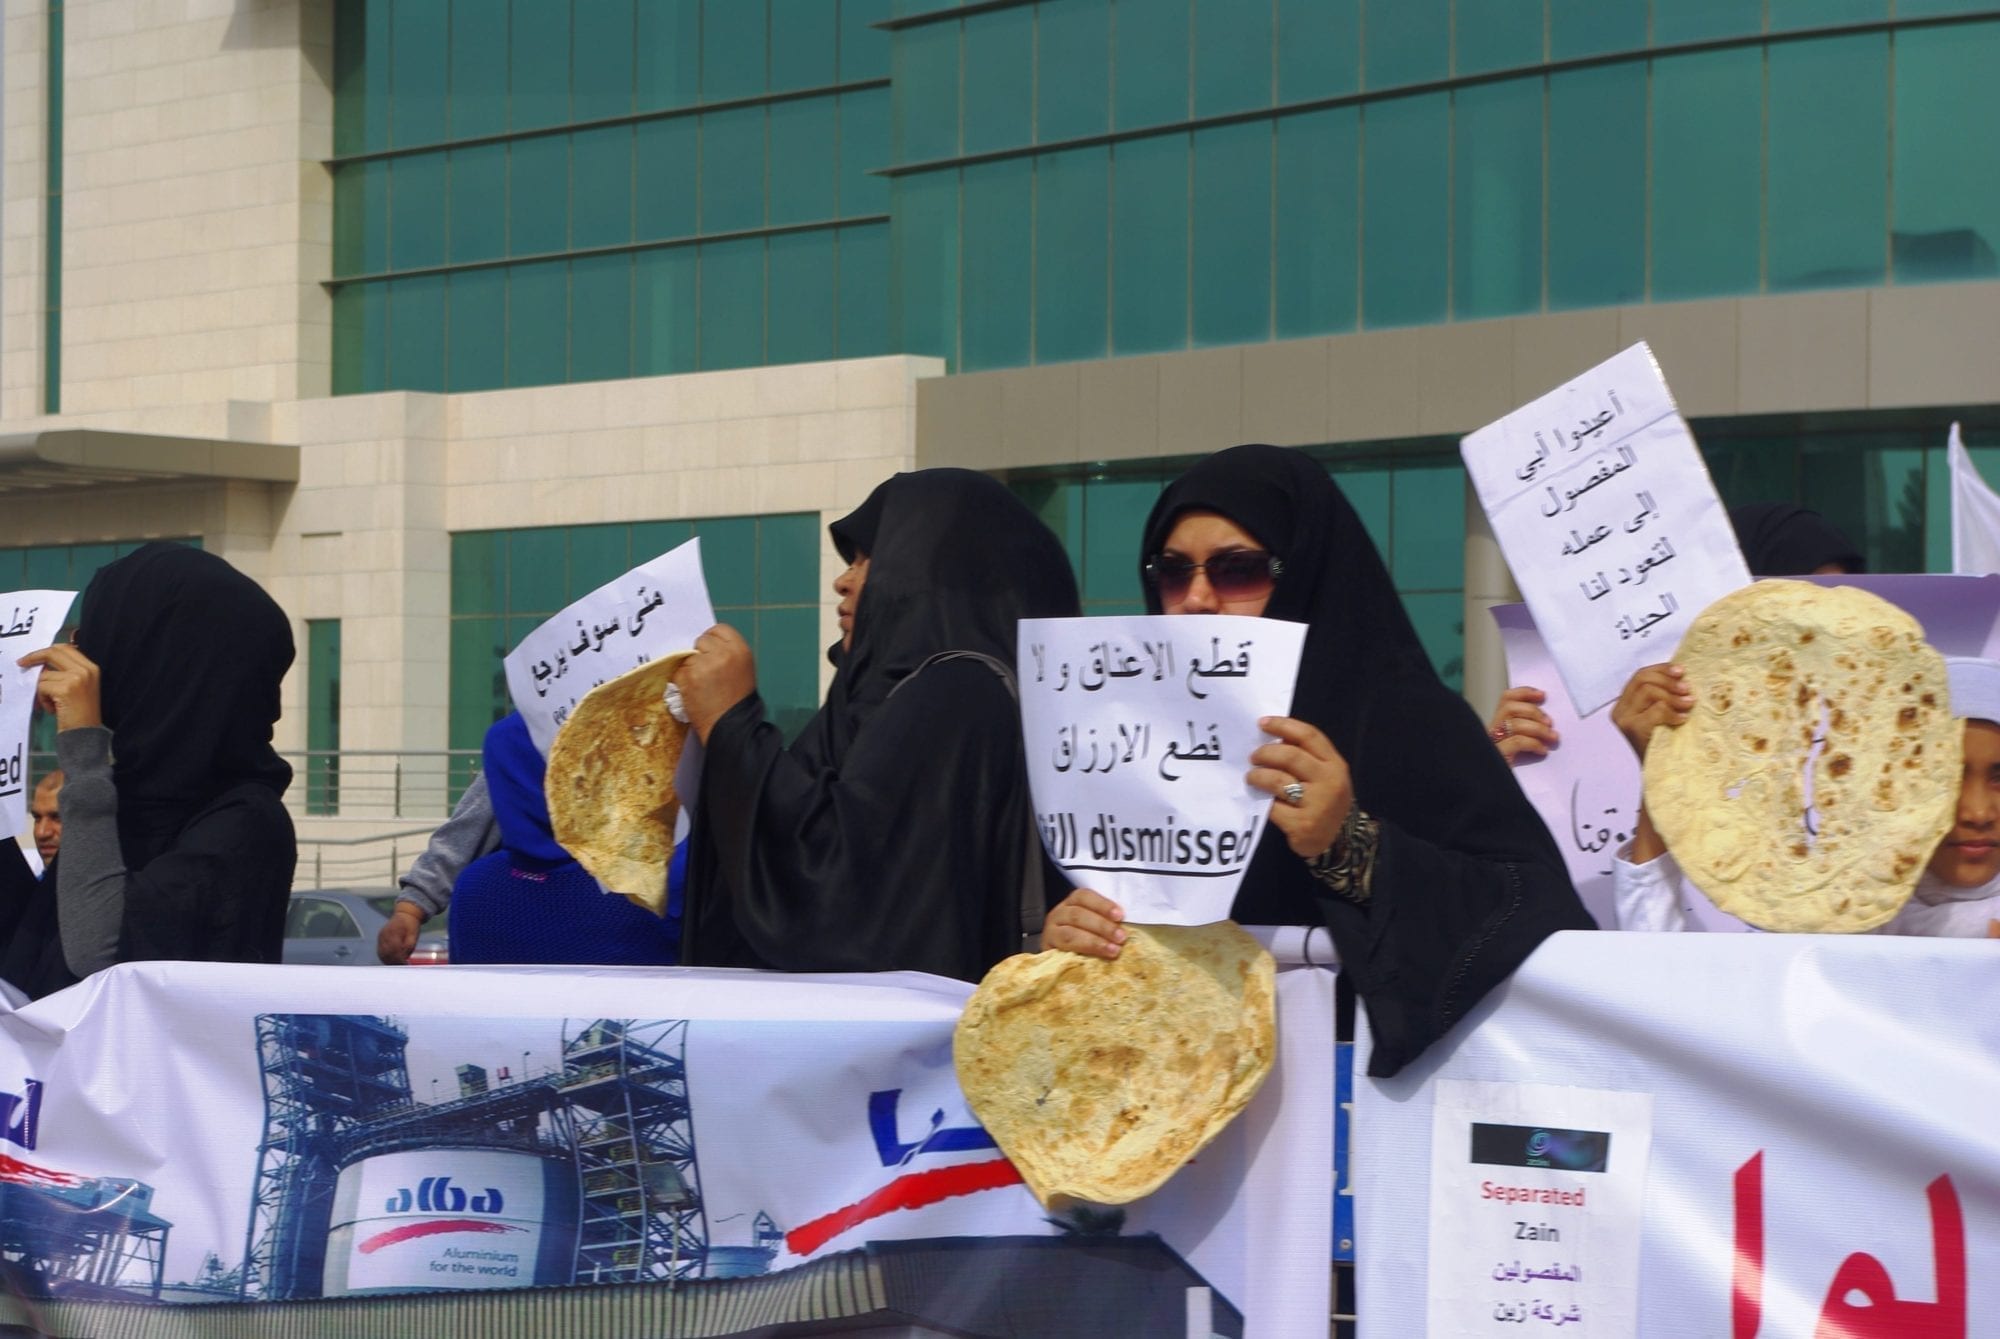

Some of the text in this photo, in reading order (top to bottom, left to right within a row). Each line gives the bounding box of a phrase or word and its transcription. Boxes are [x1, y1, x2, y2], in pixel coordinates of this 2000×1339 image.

[1541, 443, 1639, 518] المفصول
[1561, 524, 1613, 556] عمله
[1580, 536, 1677, 601] لتعود لنا
[0, 606, 39, 638] قط
[627, 587, 665, 637] متى
[1615, 592, 1680, 640] الحياة
[568, 618, 620, 656] سوف
[531, 648, 568, 698] يرجع
[1187, 637, 1254, 699] قطع
[1052, 720, 1222, 781] قطع الارزاق
[1090, 814, 1259, 866] dismissed
[385, 1177, 504, 1214] alba
[1481, 1181, 1585, 1206] Separated
[1514, 1221, 1560, 1242] Zain
[429, 1259, 518, 1277] for the world
[443, 1248, 519, 1263] Aluminium
[1492, 1260, 1582, 1284] المفصولين
[1493, 1299, 1582, 1326] شركة زين
